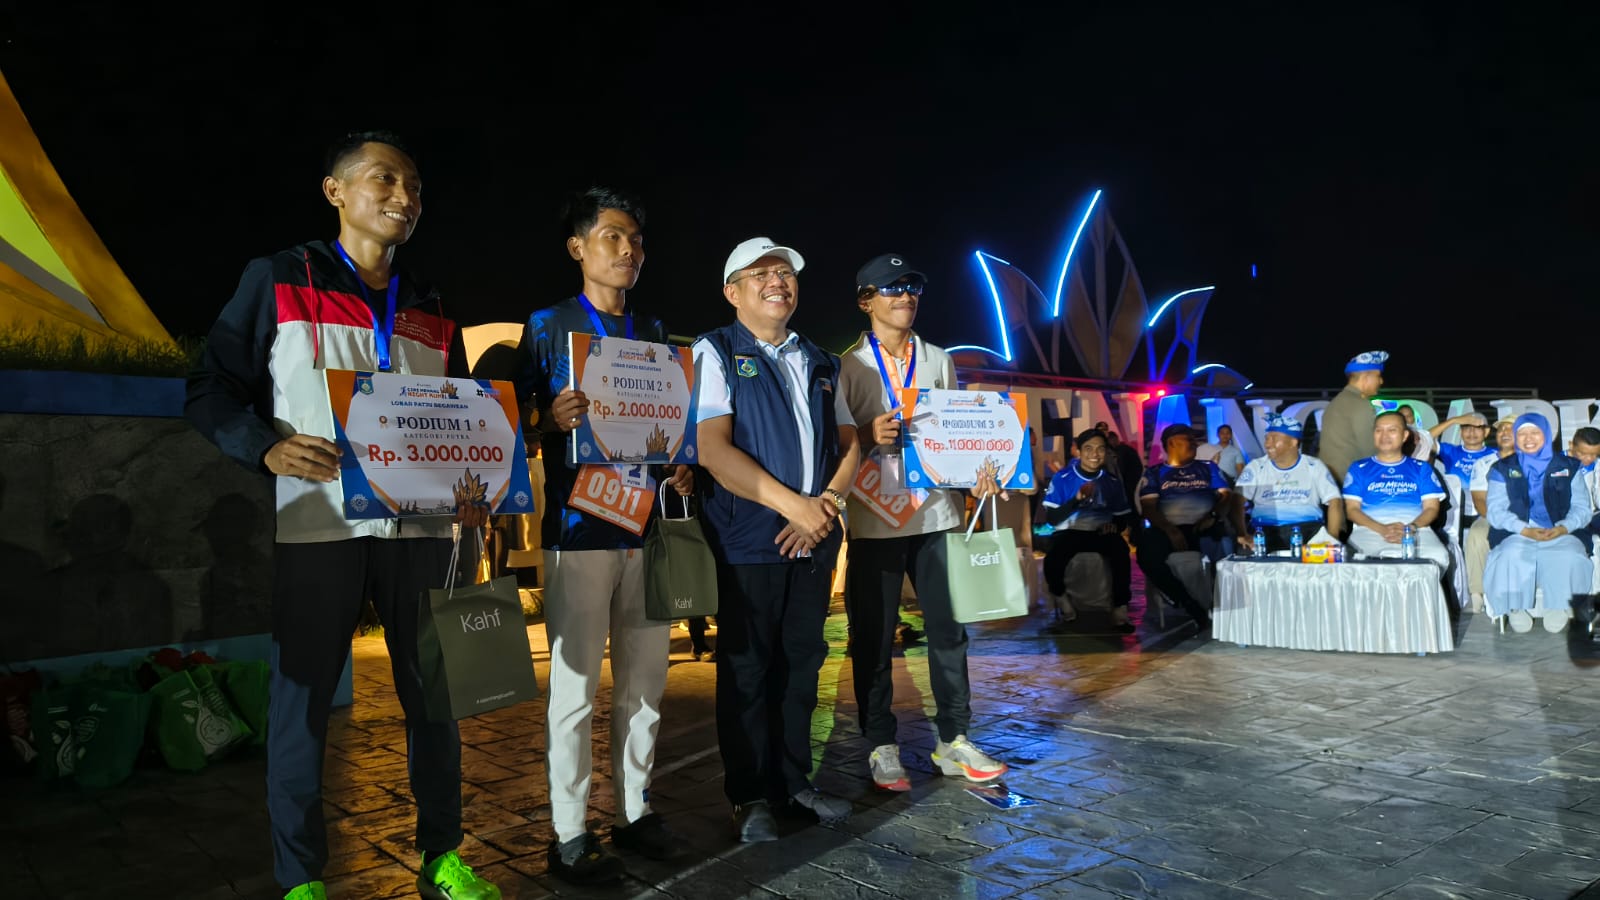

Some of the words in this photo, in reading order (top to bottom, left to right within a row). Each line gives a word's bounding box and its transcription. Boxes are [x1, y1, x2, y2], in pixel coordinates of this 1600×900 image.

[614, 376, 654, 391] PODIUM
[657, 381, 663, 391] 2
[593, 400, 614, 419] Rp.
[618, 401, 681, 419] 2.000.000
[396, 416, 461, 431] PODIUM
[464, 419, 472, 432] 1
[988, 419, 995, 429] 3
[368, 444, 402, 466] Rp.
[407, 444, 503, 462] 3.000.000
[587, 471, 641, 516] 0911
[970, 551, 1000, 567] Kahf
[460, 608, 501, 633] Kahf
